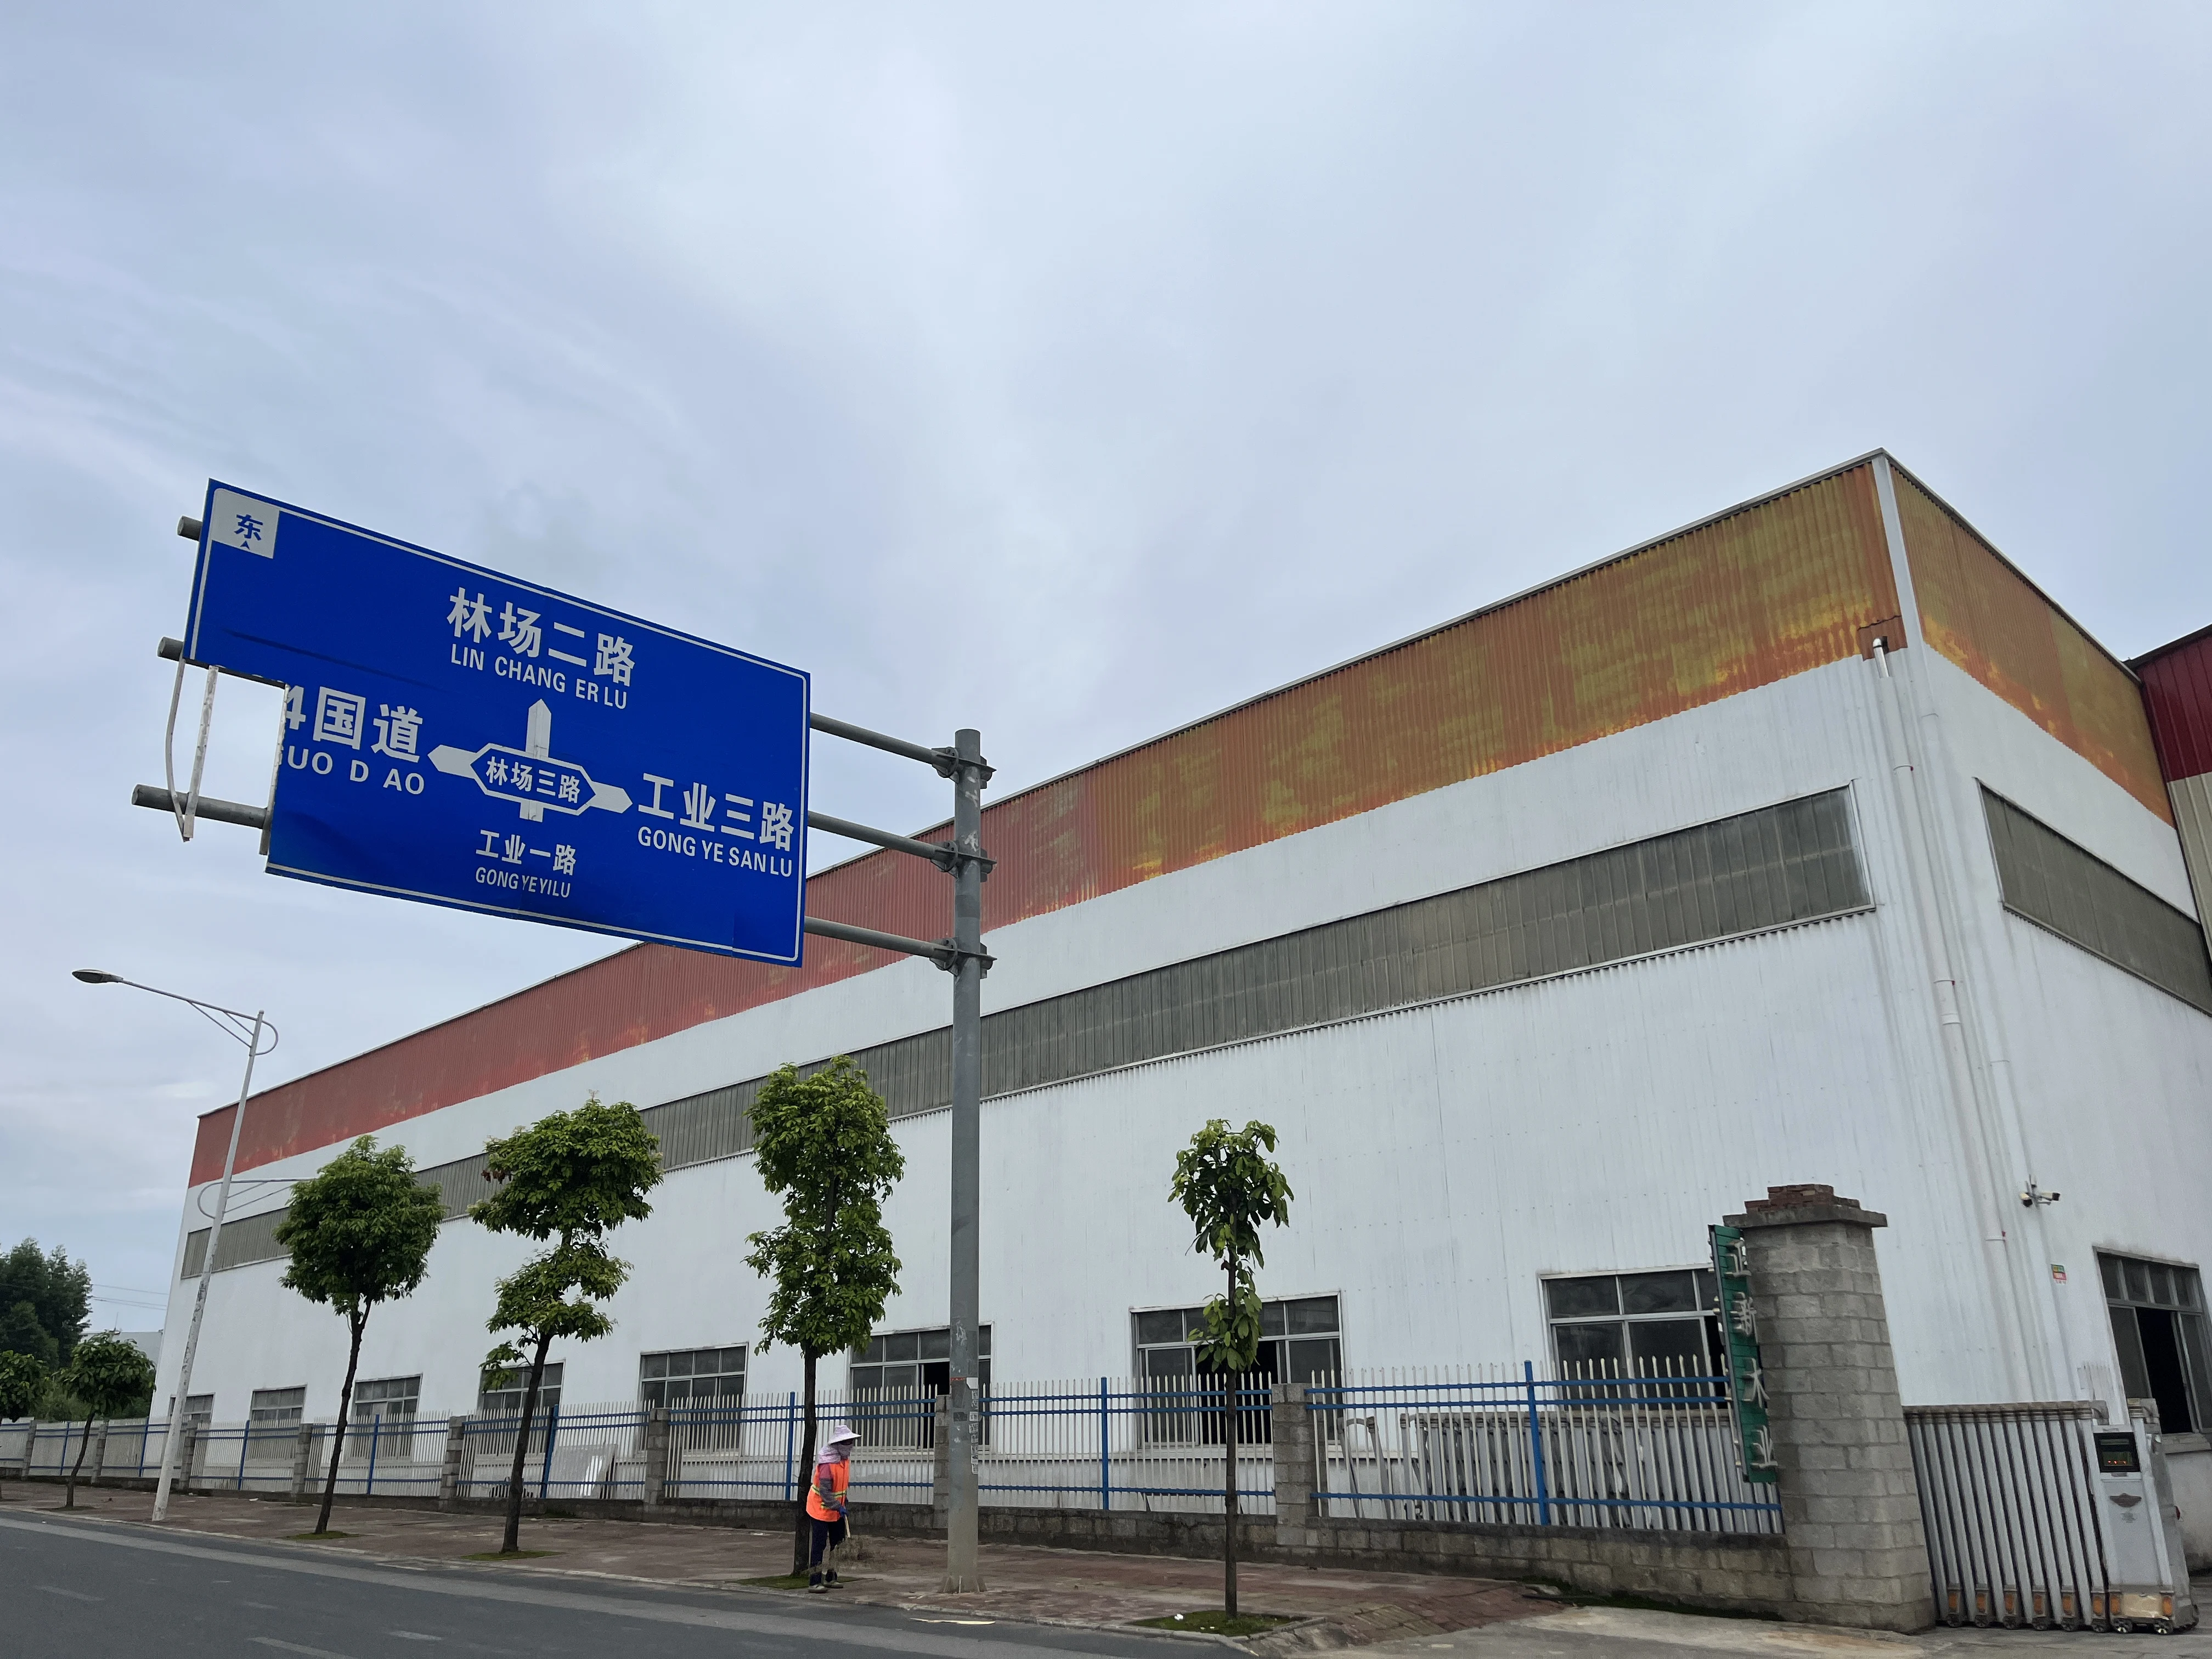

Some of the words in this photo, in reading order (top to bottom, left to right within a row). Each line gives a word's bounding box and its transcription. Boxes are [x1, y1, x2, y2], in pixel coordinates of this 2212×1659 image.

[234, 514, 263, 541] 东
[447, 586, 635, 687] 林场二路
[451, 644, 484, 671] LIN
[495, 656, 566, 693] CHANG
[575, 679, 599, 703] ER
[604, 686, 627, 709] LU
[486, 756, 580, 804] 林场三路
[638, 772, 794, 852] 工业三路
[476, 829, 577, 876] 工业一路
[638, 826, 696, 856] GONG
[701, 839, 724, 863] YE
[729, 847, 766, 872] SAN
[770, 856, 792, 877] LU
